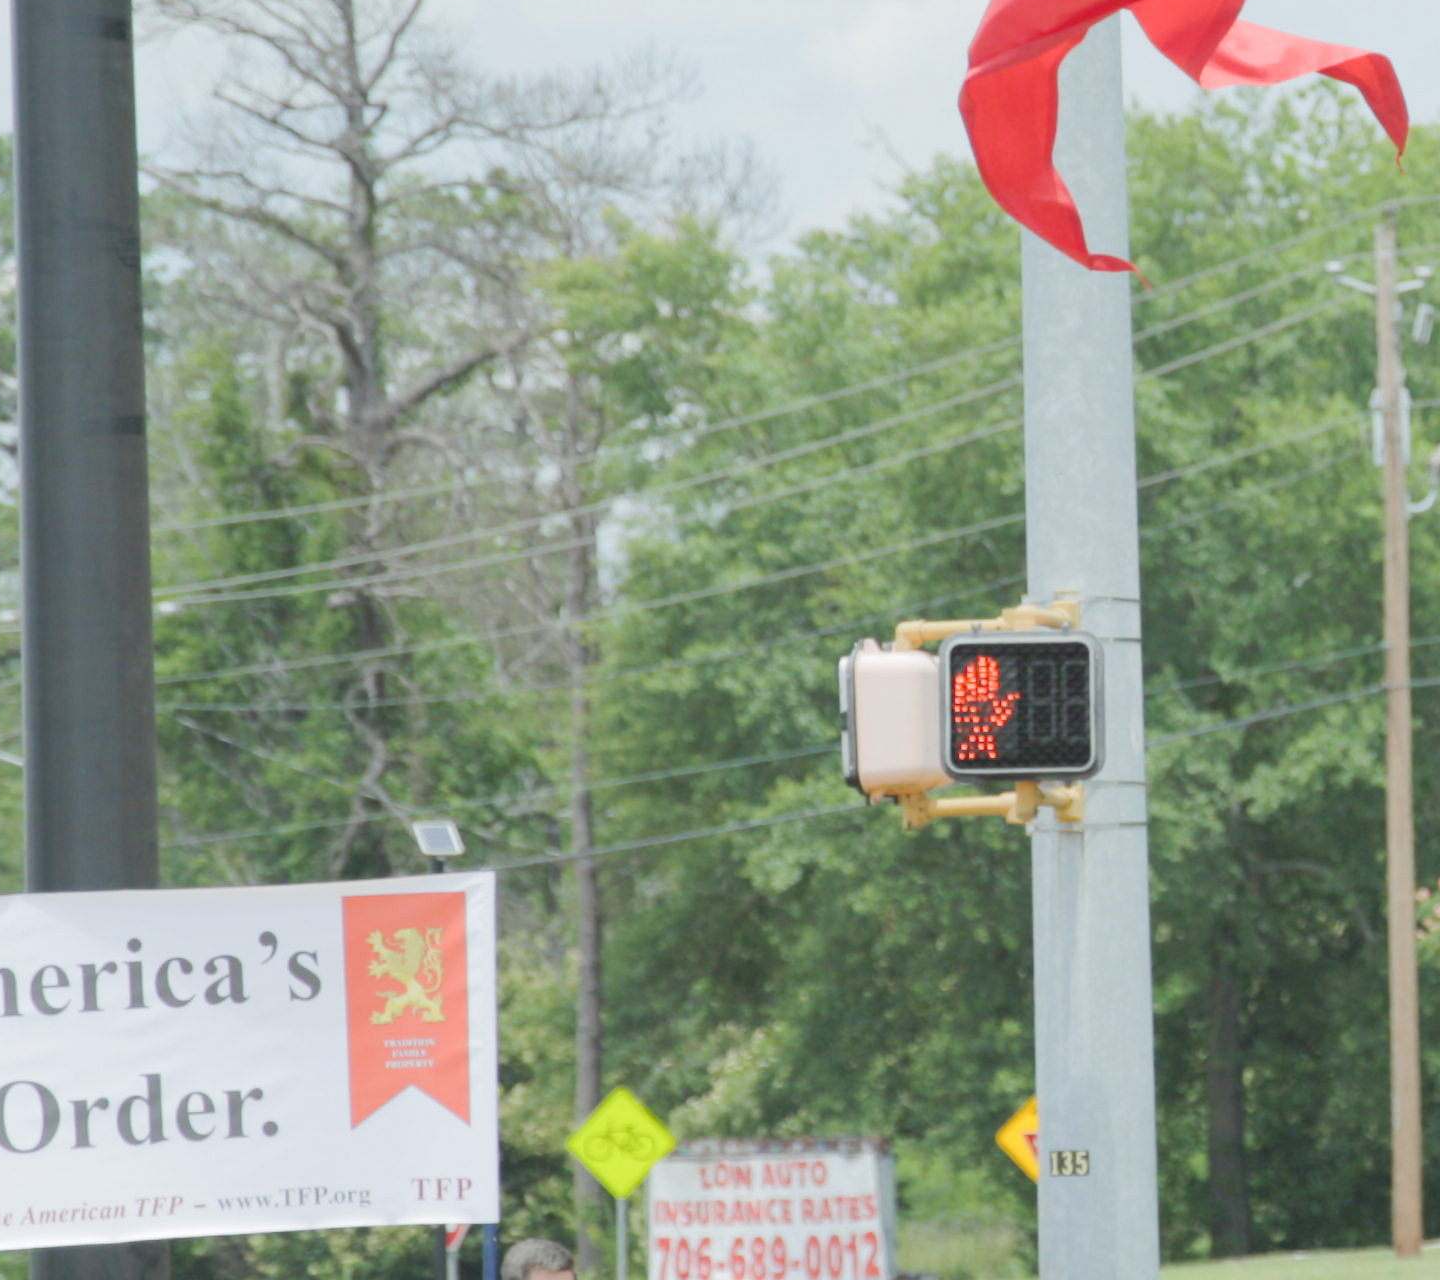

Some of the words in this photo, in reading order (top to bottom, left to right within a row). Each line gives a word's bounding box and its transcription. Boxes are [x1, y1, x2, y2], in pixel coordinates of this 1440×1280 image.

[763, 1160, 829, 1187] AUTO
[1051, 1151, 1088, 1176] 135
[410, 1177, 474, 1202] TFP
[21, 1203, 126, 1226] American
[135, 1195, 184, 1217] TFP
[216, 1186, 372, 1211] www.TFP.org
[655, 1198, 793, 1226] INSURANCE
[801, 1195, 879, 1224] RATES
